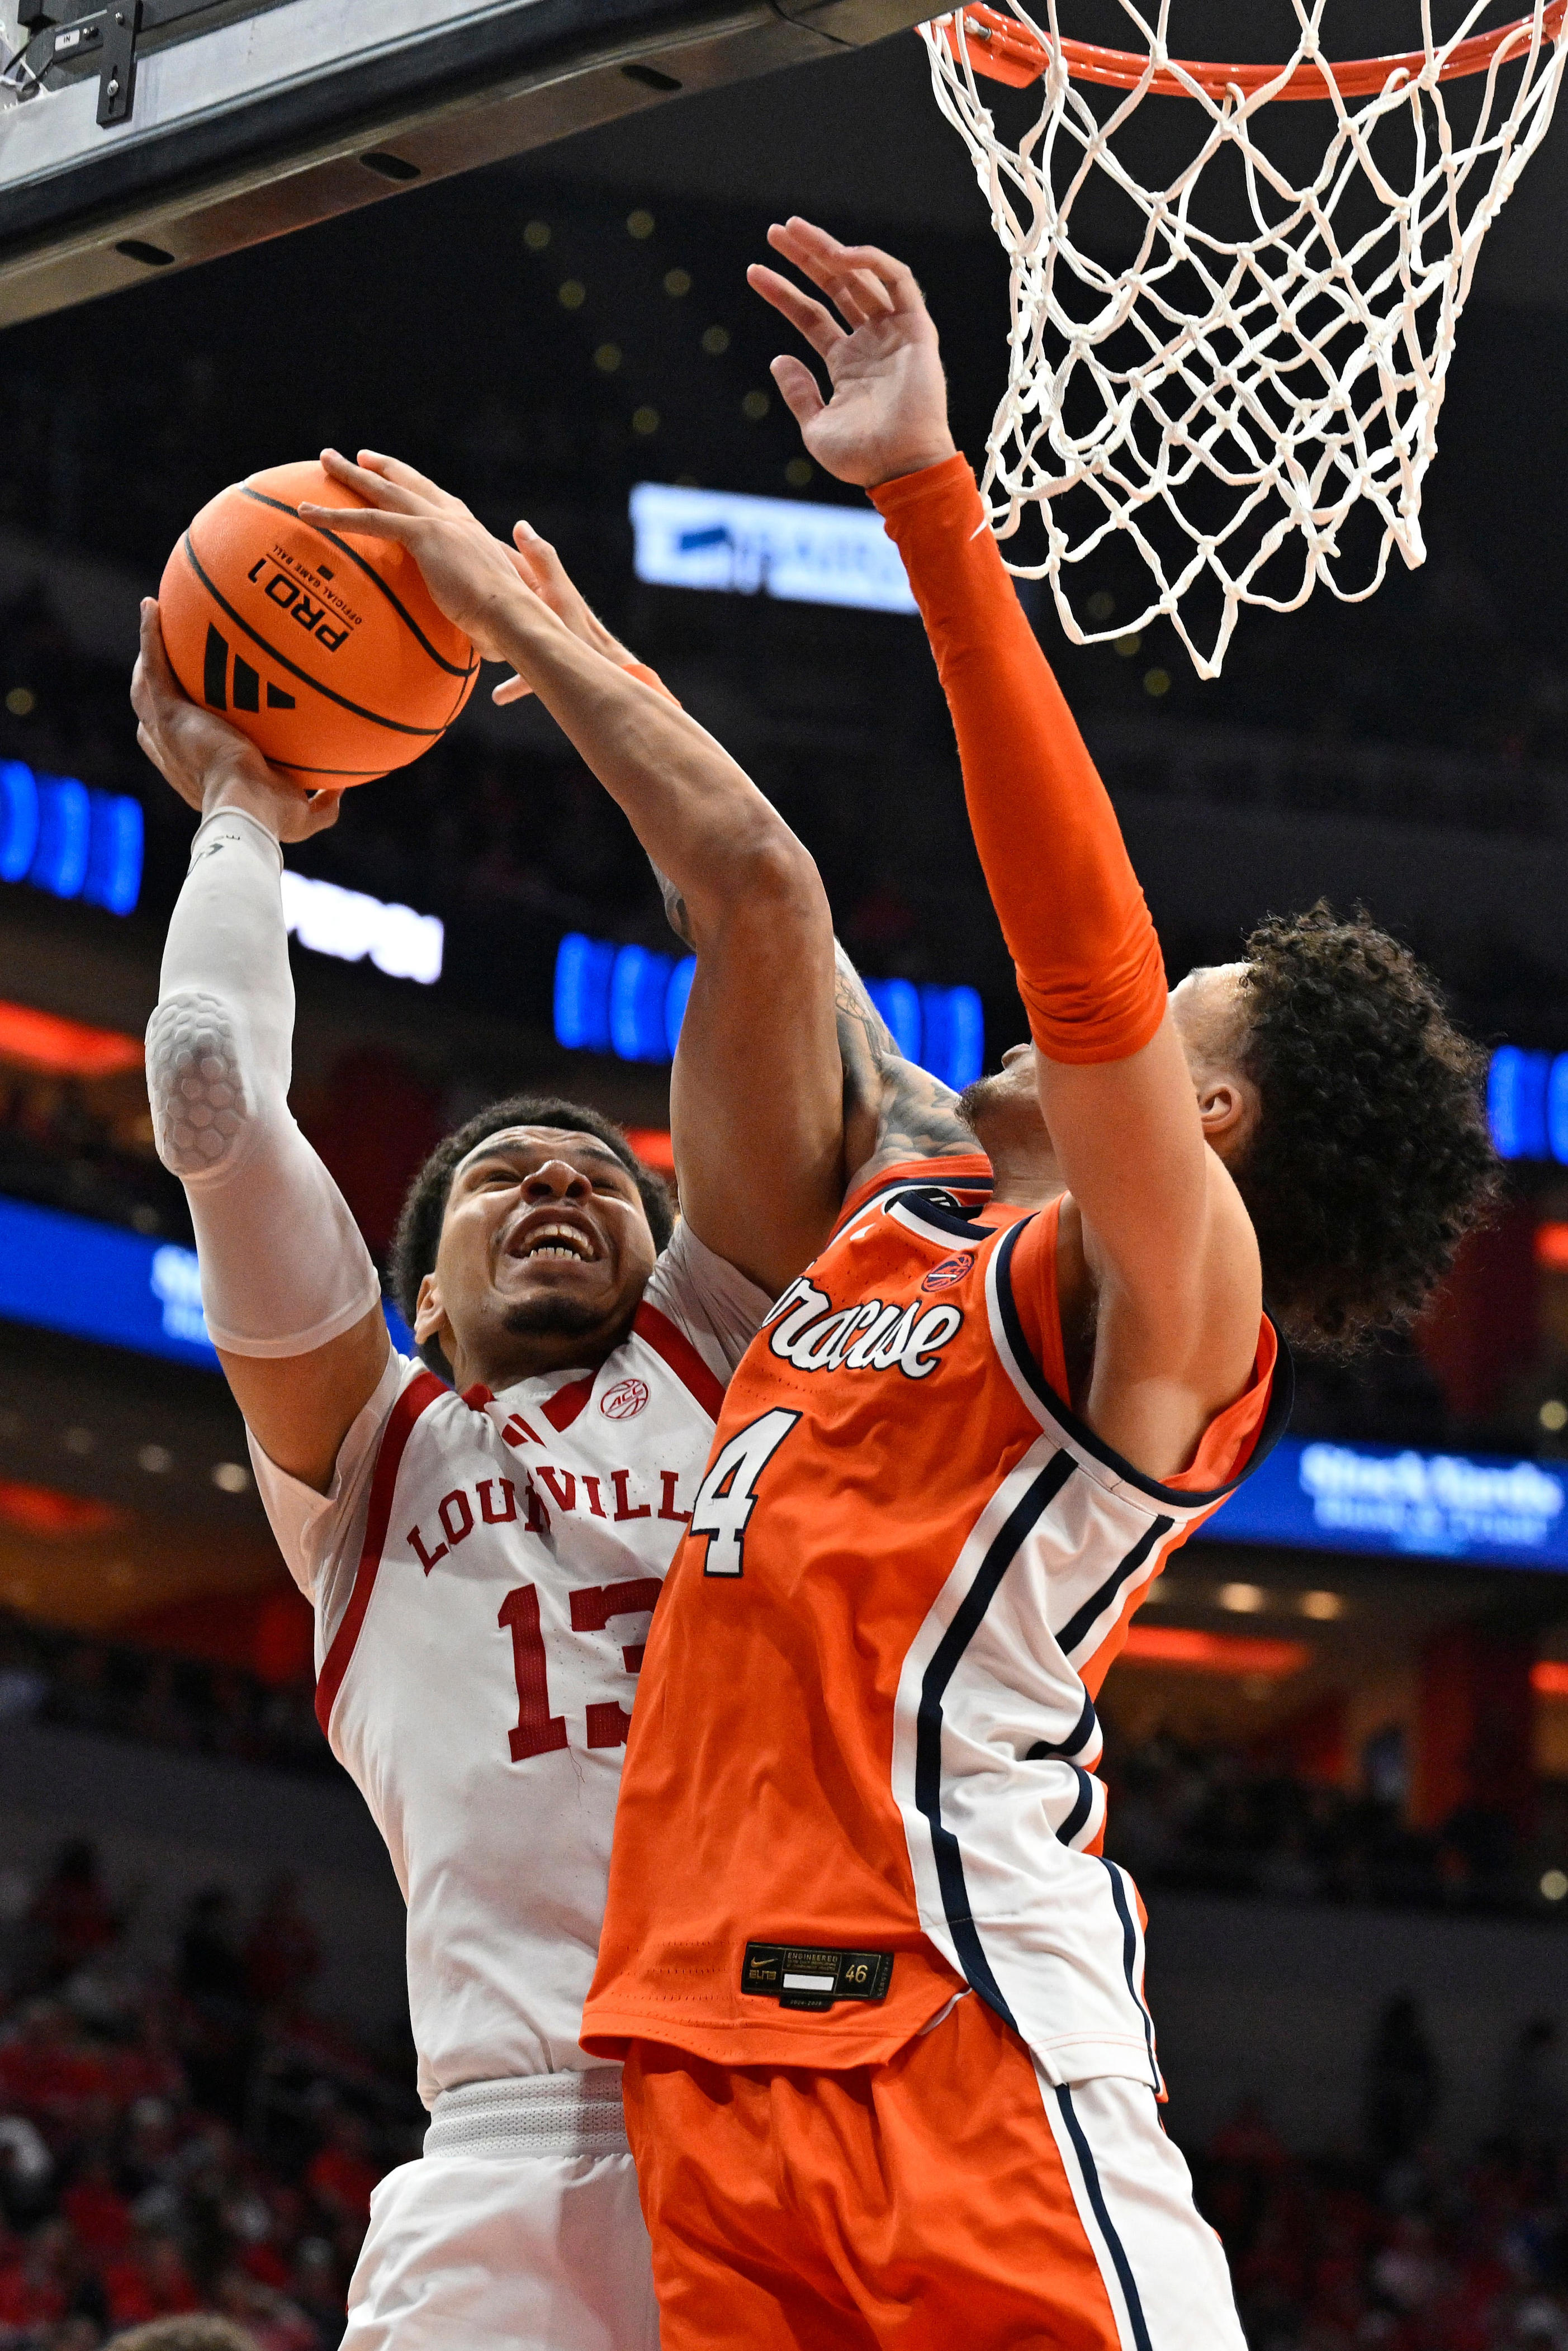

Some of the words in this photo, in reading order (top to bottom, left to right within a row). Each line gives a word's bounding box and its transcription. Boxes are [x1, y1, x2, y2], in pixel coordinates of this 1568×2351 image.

[64, 35, 71, 44] IN
[273, 544, 294, 565] BALL
[248, 557, 267, 583] 1
[294, 563, 321, 587] GAME
[264, 573, 349, 652] PRO
[322, 586, 362, 625] OFFICIAL
[761, 1276, 964, 1380] racuse
[688, 1406, 803, 1577] 4
[407, 1466, 694, 1577] LOUIVILL
[787, 1951, 838, 1963] ENGINEERED
[845, 1964, 868, 1983] 46
